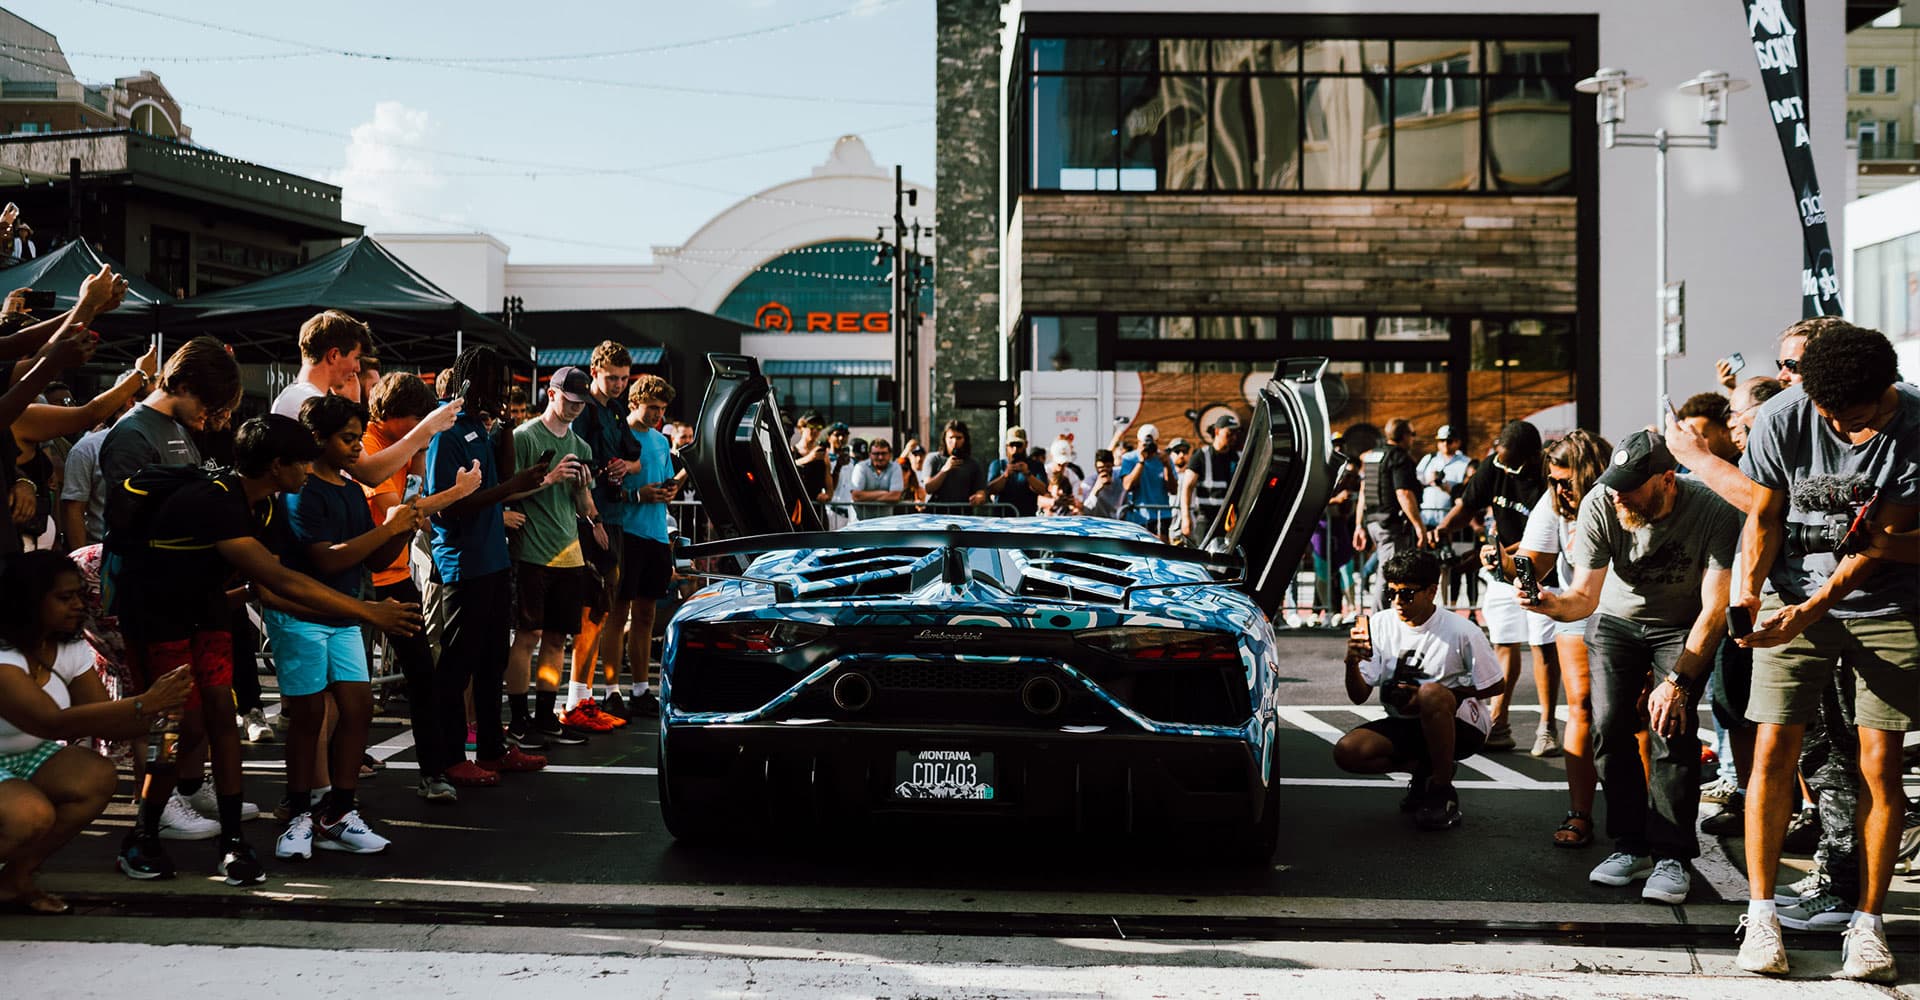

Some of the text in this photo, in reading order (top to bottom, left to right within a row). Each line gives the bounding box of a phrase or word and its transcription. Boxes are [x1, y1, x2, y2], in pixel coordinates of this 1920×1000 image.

[807, 311, 890, 333] REG
[918, 751, 971, 761] MONTANA
[913, 762, 977, 786] CDC403
